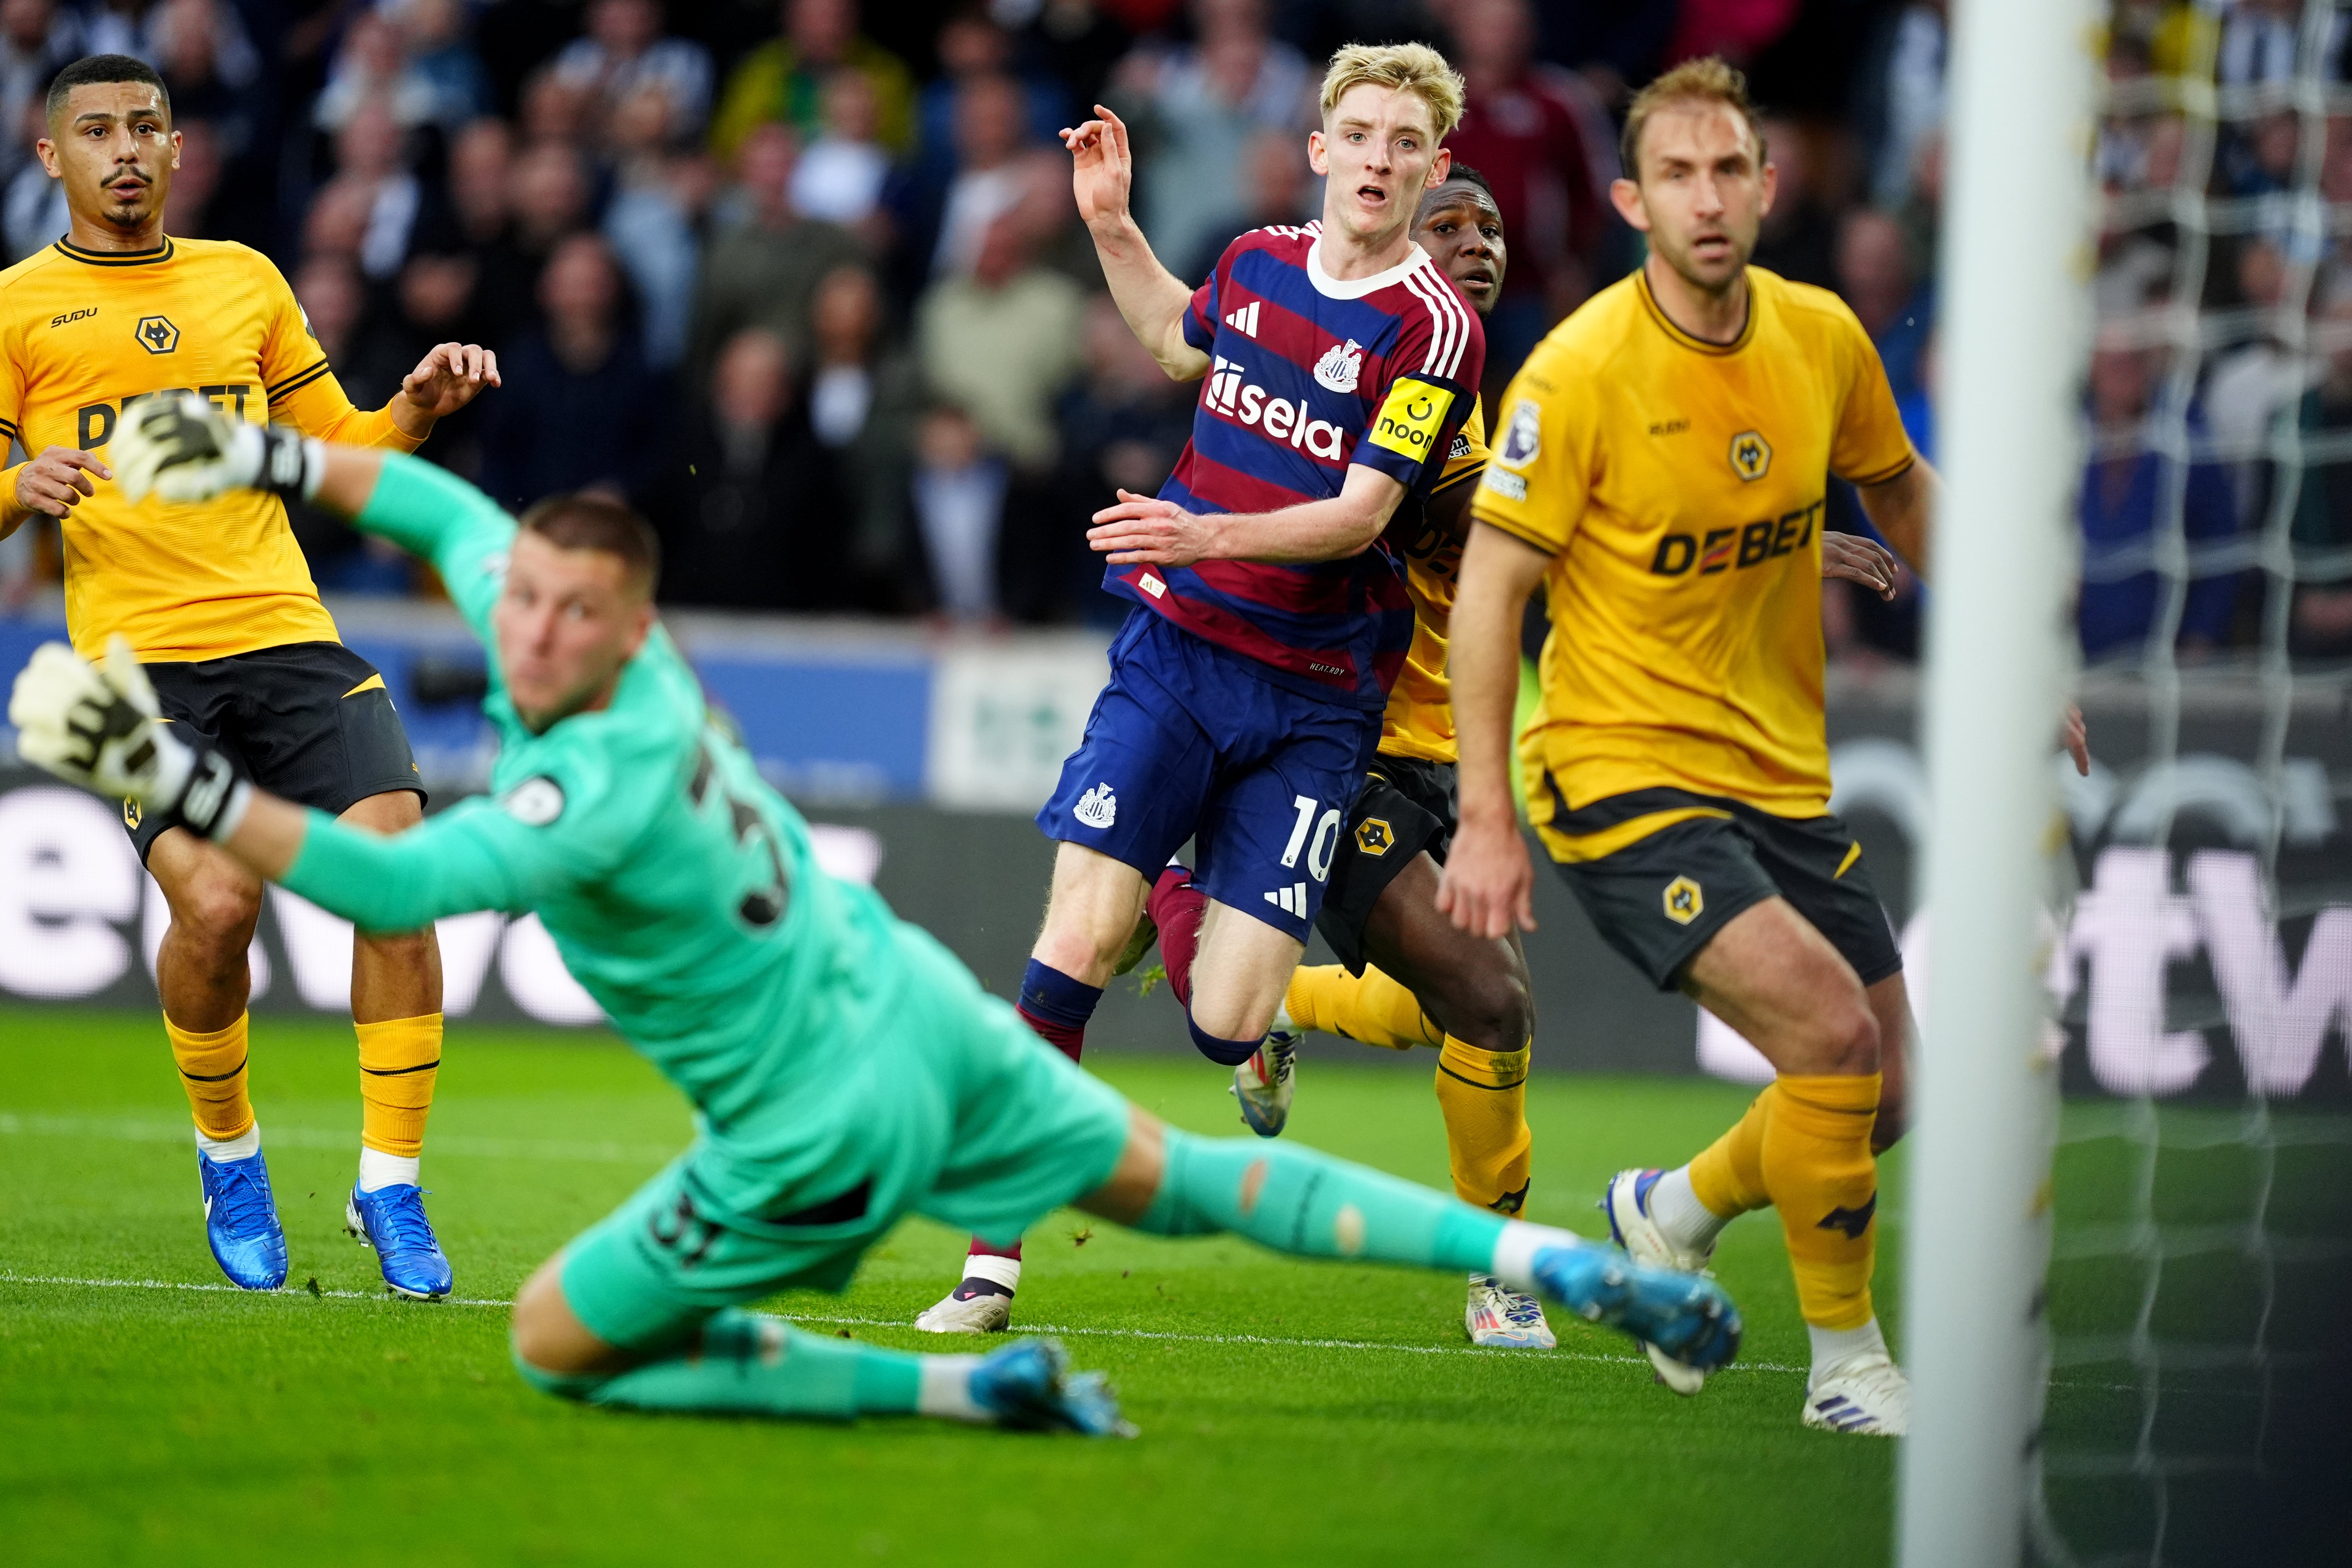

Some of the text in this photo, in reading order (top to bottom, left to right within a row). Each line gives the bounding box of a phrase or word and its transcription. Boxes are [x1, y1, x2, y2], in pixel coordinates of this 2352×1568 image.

[51, 307, 98, 328] SUDU
[1318, 374, 1334, 388] NEWCASTLE
[1238, 385, 1343, 461] sela
[1379, 417, 1432, 450] noon
[1651, 499, 1826, 578] DEBET
[1310, 662, 1345, 676] HEAT.RDY
[1280, 794, 1341, 882] 10
